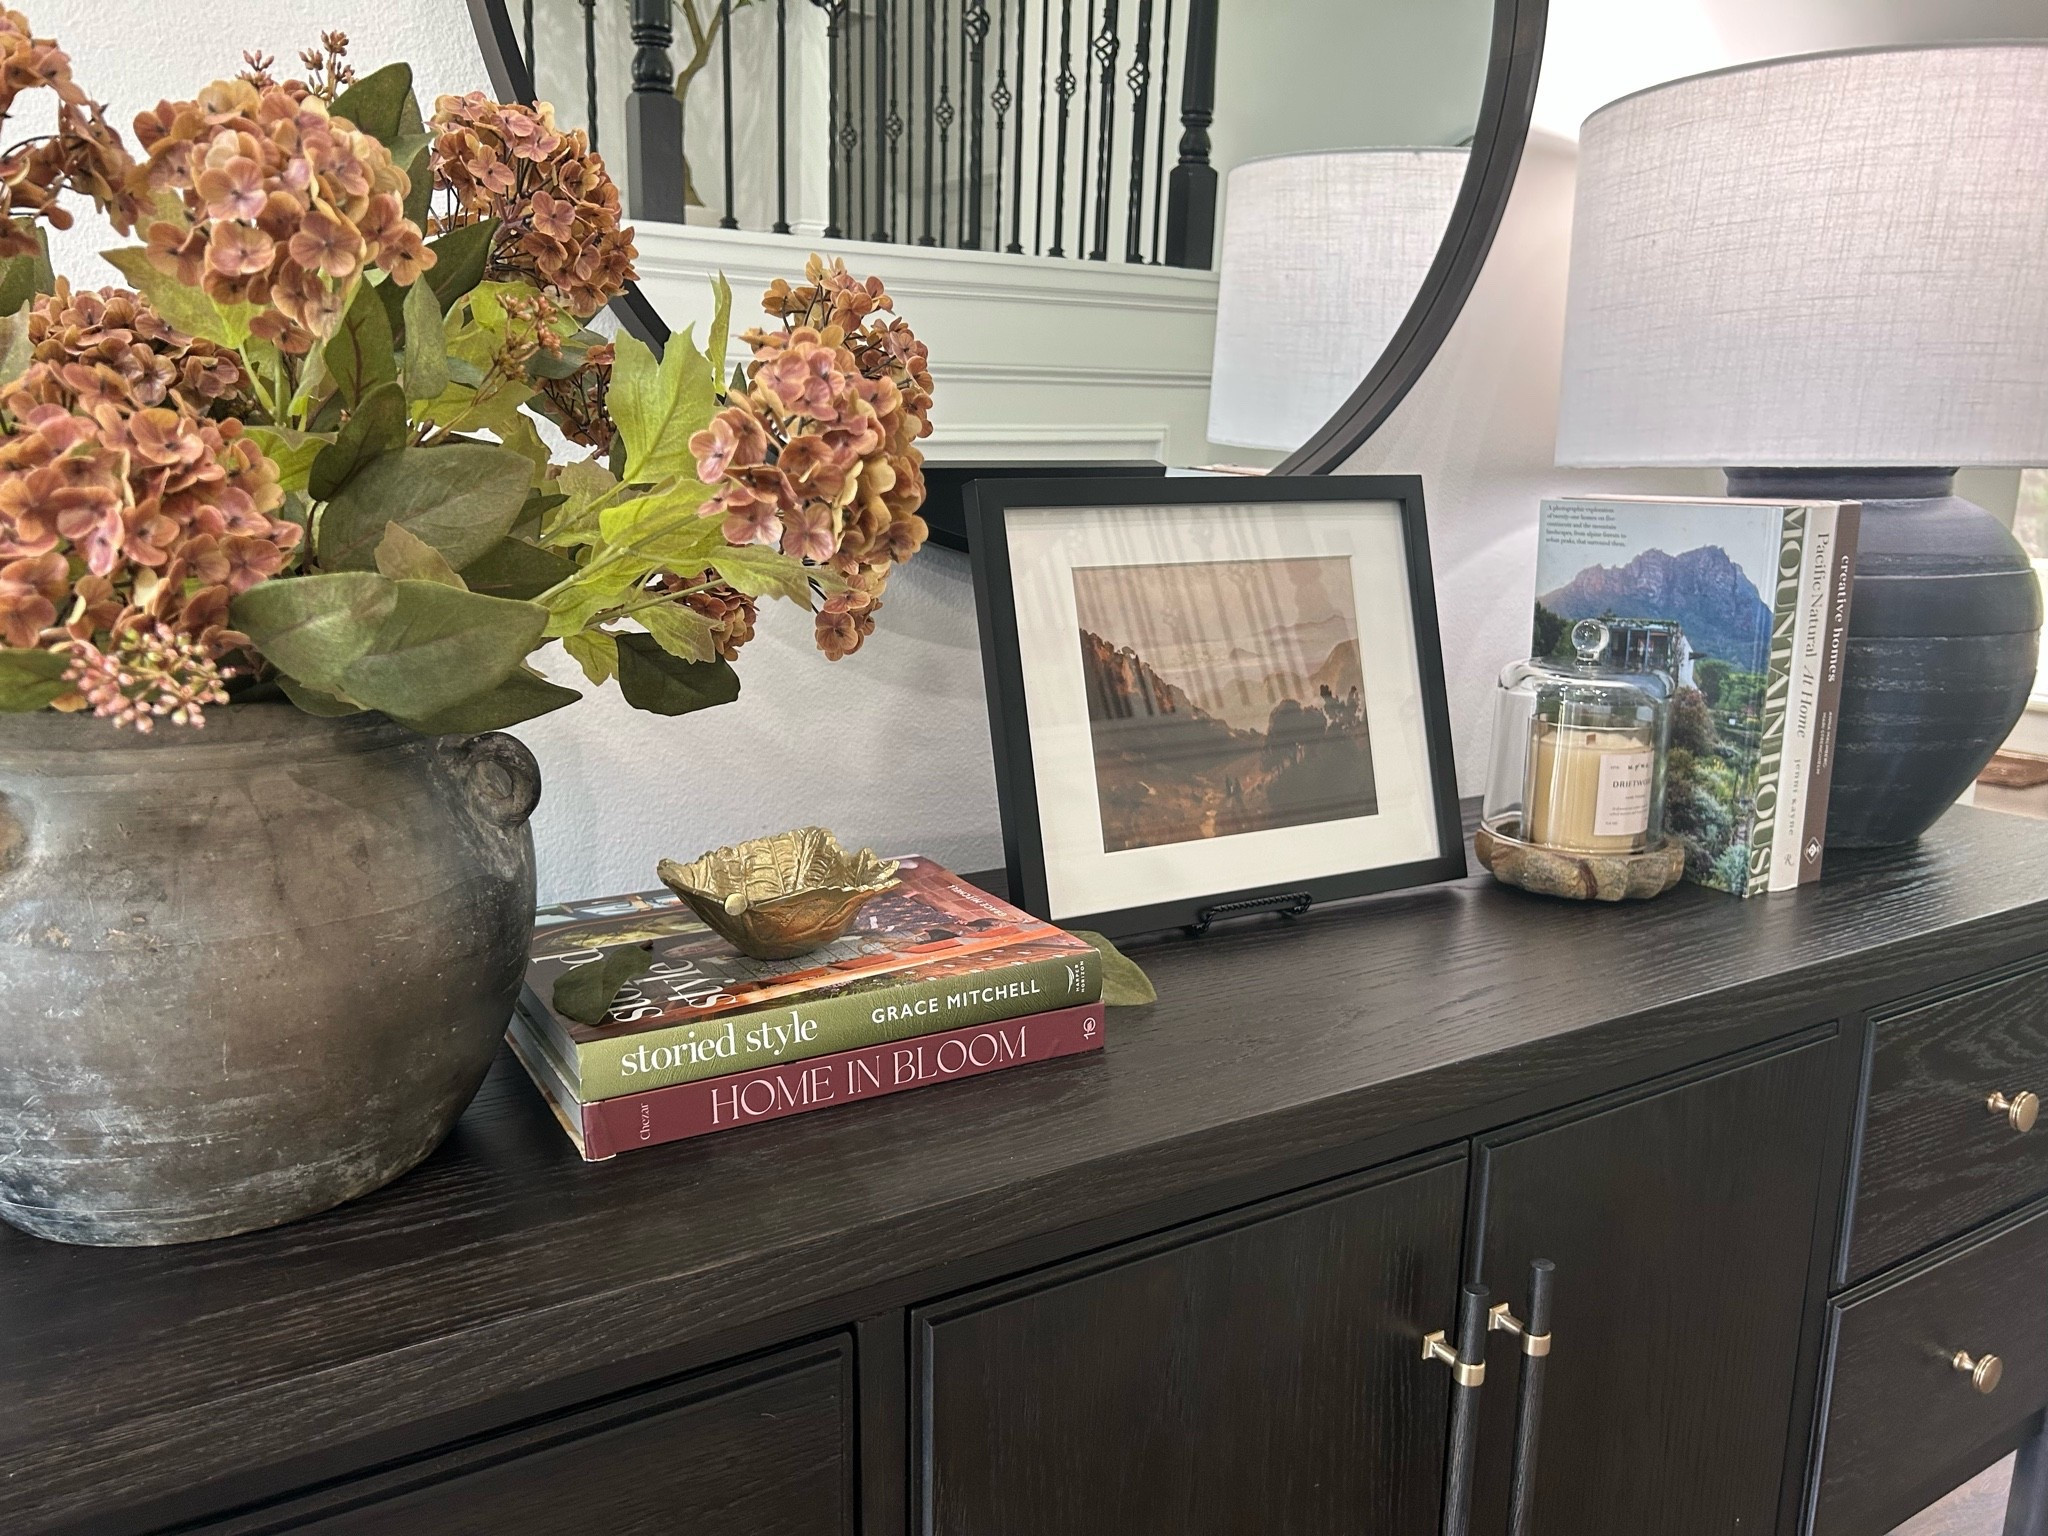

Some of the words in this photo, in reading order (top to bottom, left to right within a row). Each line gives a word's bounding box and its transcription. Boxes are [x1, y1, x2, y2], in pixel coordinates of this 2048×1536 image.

[1812, 533, 1830, 592] Pacific
[1834, 555, 1849, 623] creative
[1762, 507, 1805, 739] MOUNTAIN
[1805, 594, 1824, 658] Natural
[1802, 664, 1814, 685] At
[1827, 627, 1844, 683] homes
[1797, 691, 1813, 738] Home
[1612, 778, 1651, 788] DRIFTWO
[1792, 758, 1801, 793] jenni
[1748, 752, 1781, 893] HOUSE
[947, 884, 983, 904] MITCHELL
[980, 902, 1008, 917] GRACE
[633, 959, 738, 1009] style
[871, 997, 939, 1024] GRACE
[947, 979, 1040, 1009] MITCHELL
[621, 1022, 736, 1076] storied
[746, 1011, 818, 1056] style
[711, 1065, 835, 1124] HOME
[847, 1055, 880, 1095] IN
[893, 1026, 1026, 1085] BLOOM
[639, 1102, 649, 1141] Chezar
